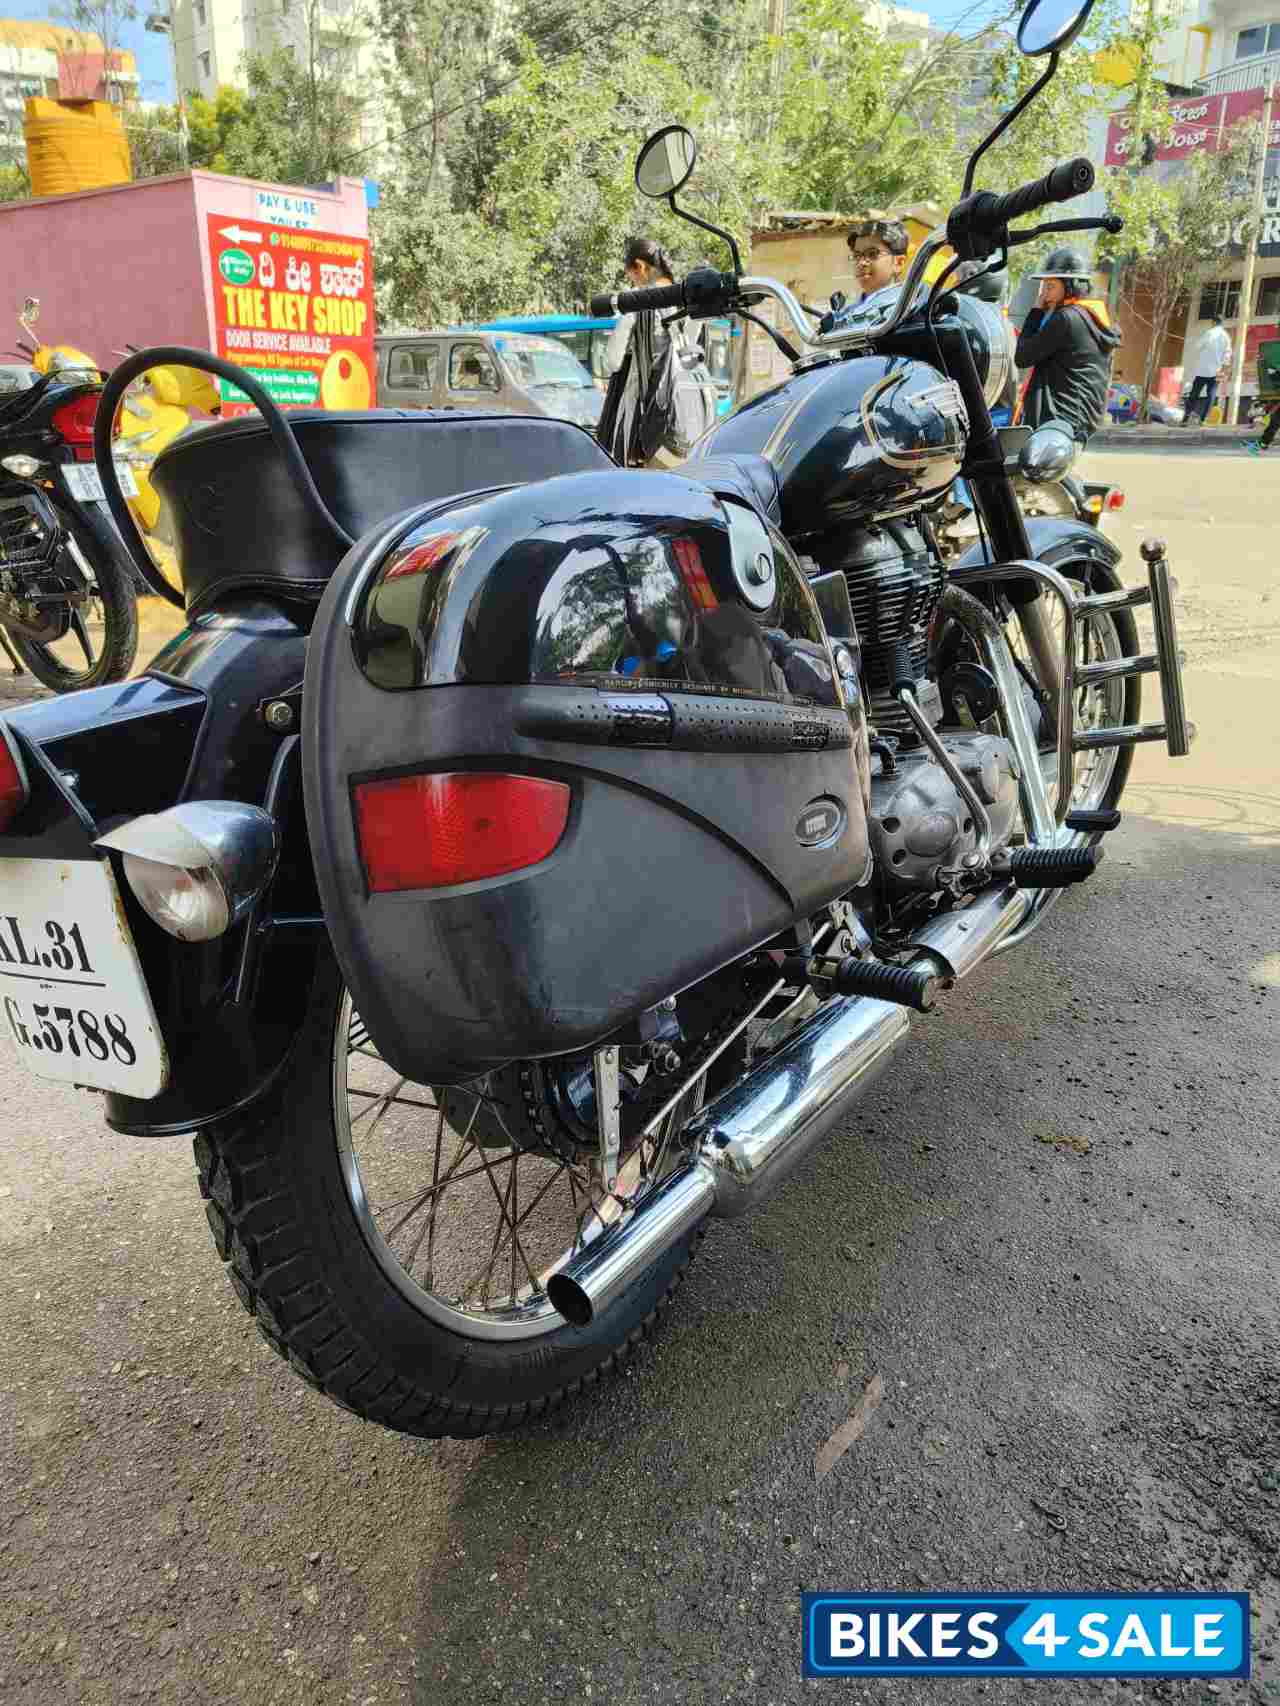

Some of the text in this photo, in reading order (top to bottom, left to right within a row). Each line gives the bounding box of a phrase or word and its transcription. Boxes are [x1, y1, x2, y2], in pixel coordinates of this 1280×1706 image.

[258, 192, 281, 208] PAY
[295, 200, 318, 216] USE
[223, 286, 367, 336] THE KEY SHOP
[225, 328, 331, 354] DOOR SERVICE AVAILABLE
[5, 996, 136, 1066] G.5788
